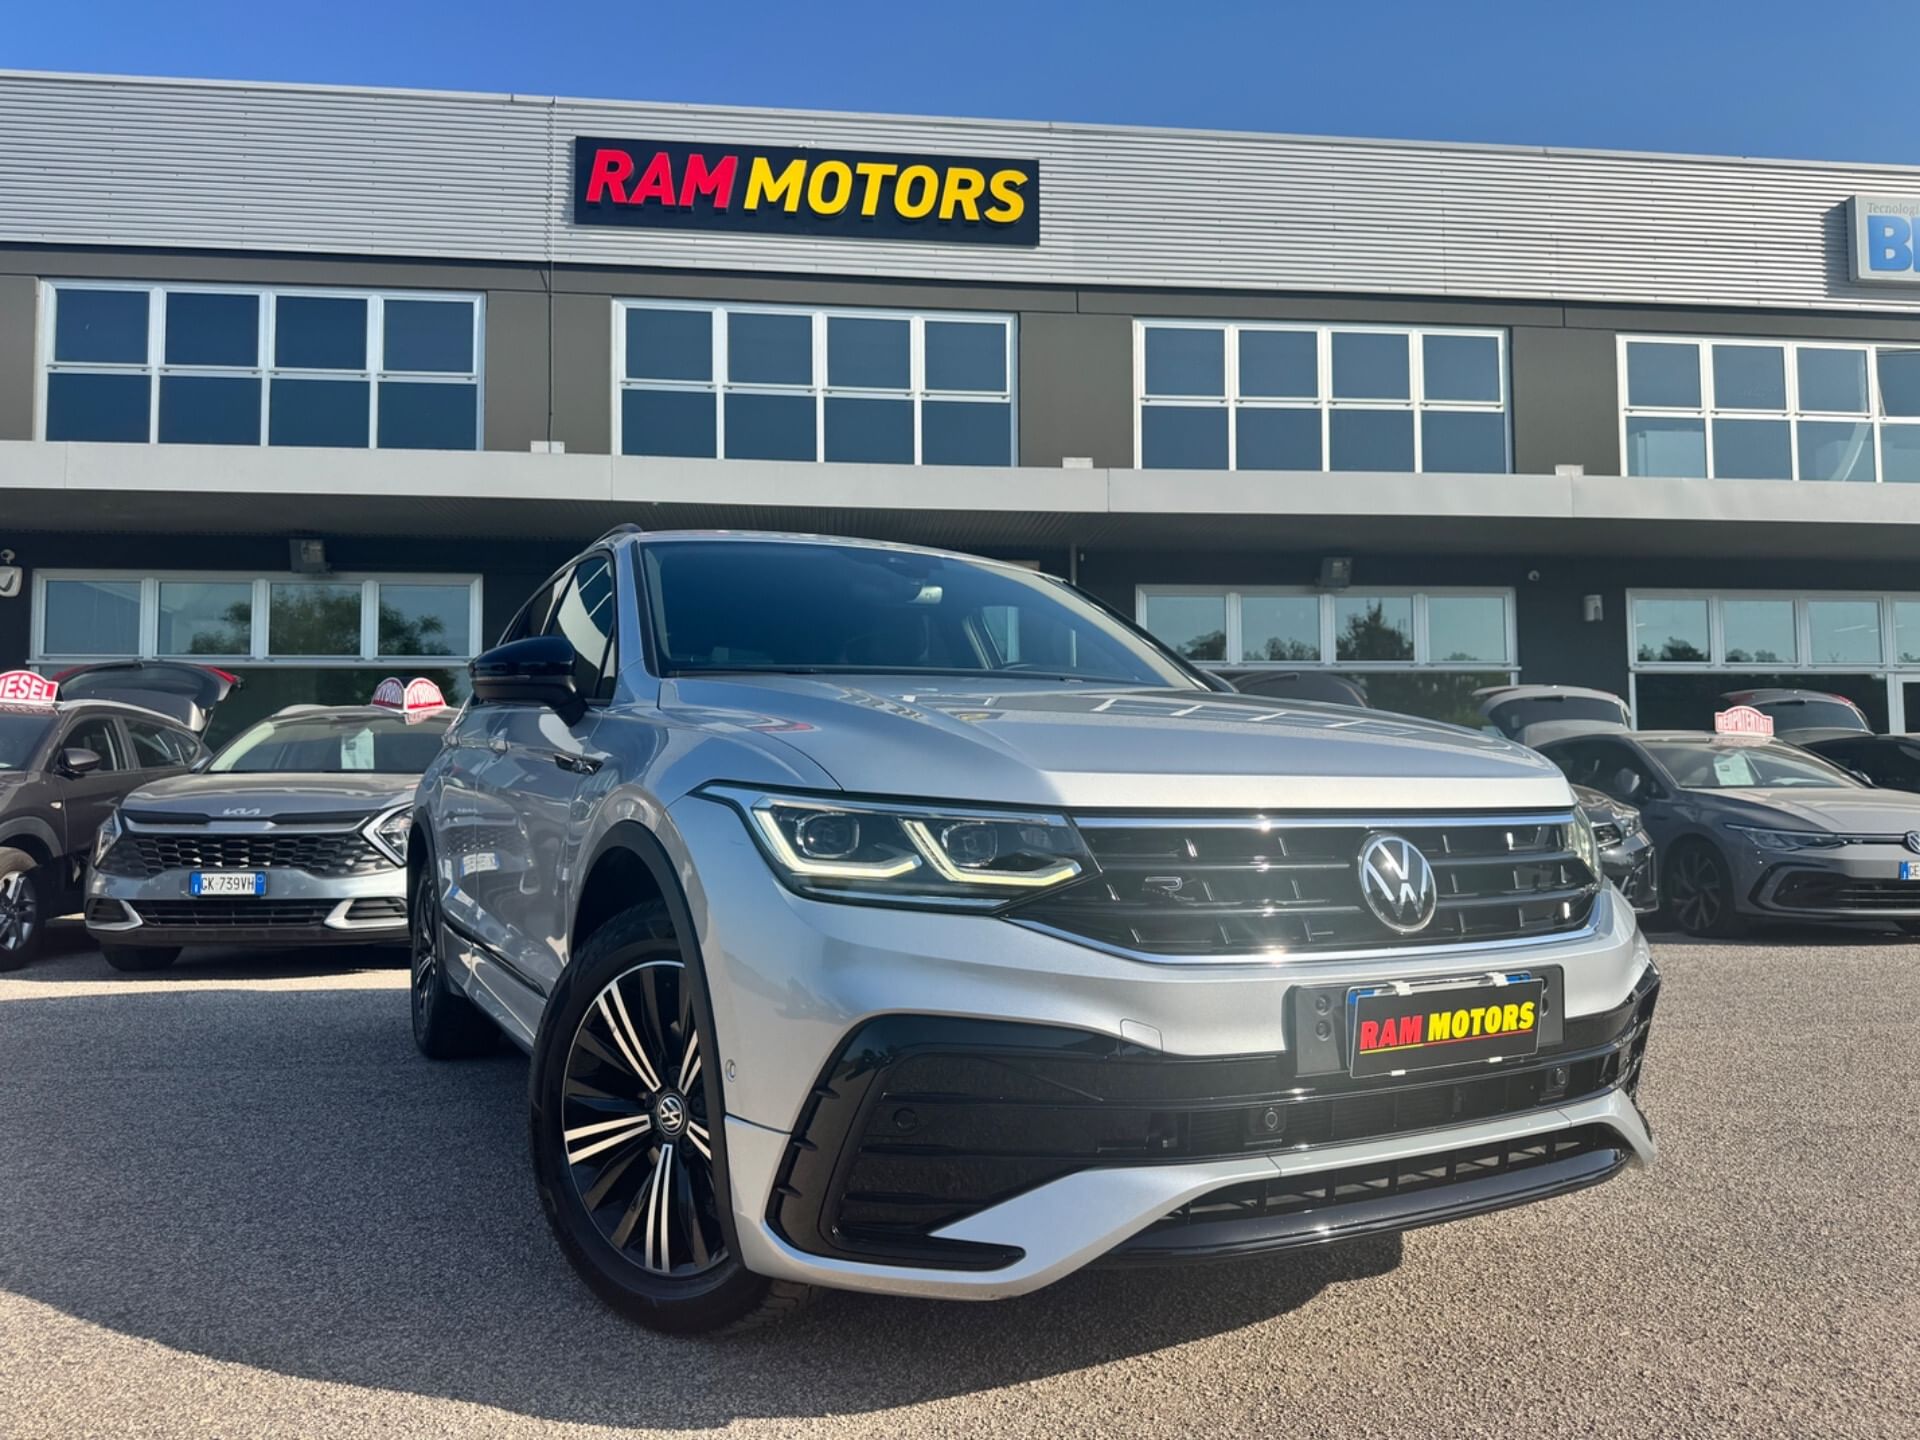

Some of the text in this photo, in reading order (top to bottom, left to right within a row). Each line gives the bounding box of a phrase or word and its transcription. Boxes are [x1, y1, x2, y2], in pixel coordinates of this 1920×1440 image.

[586, 149, 1028, 223] RAM MOTORS
[1360, 1001, 1535, 1050] RAM MOTORS
